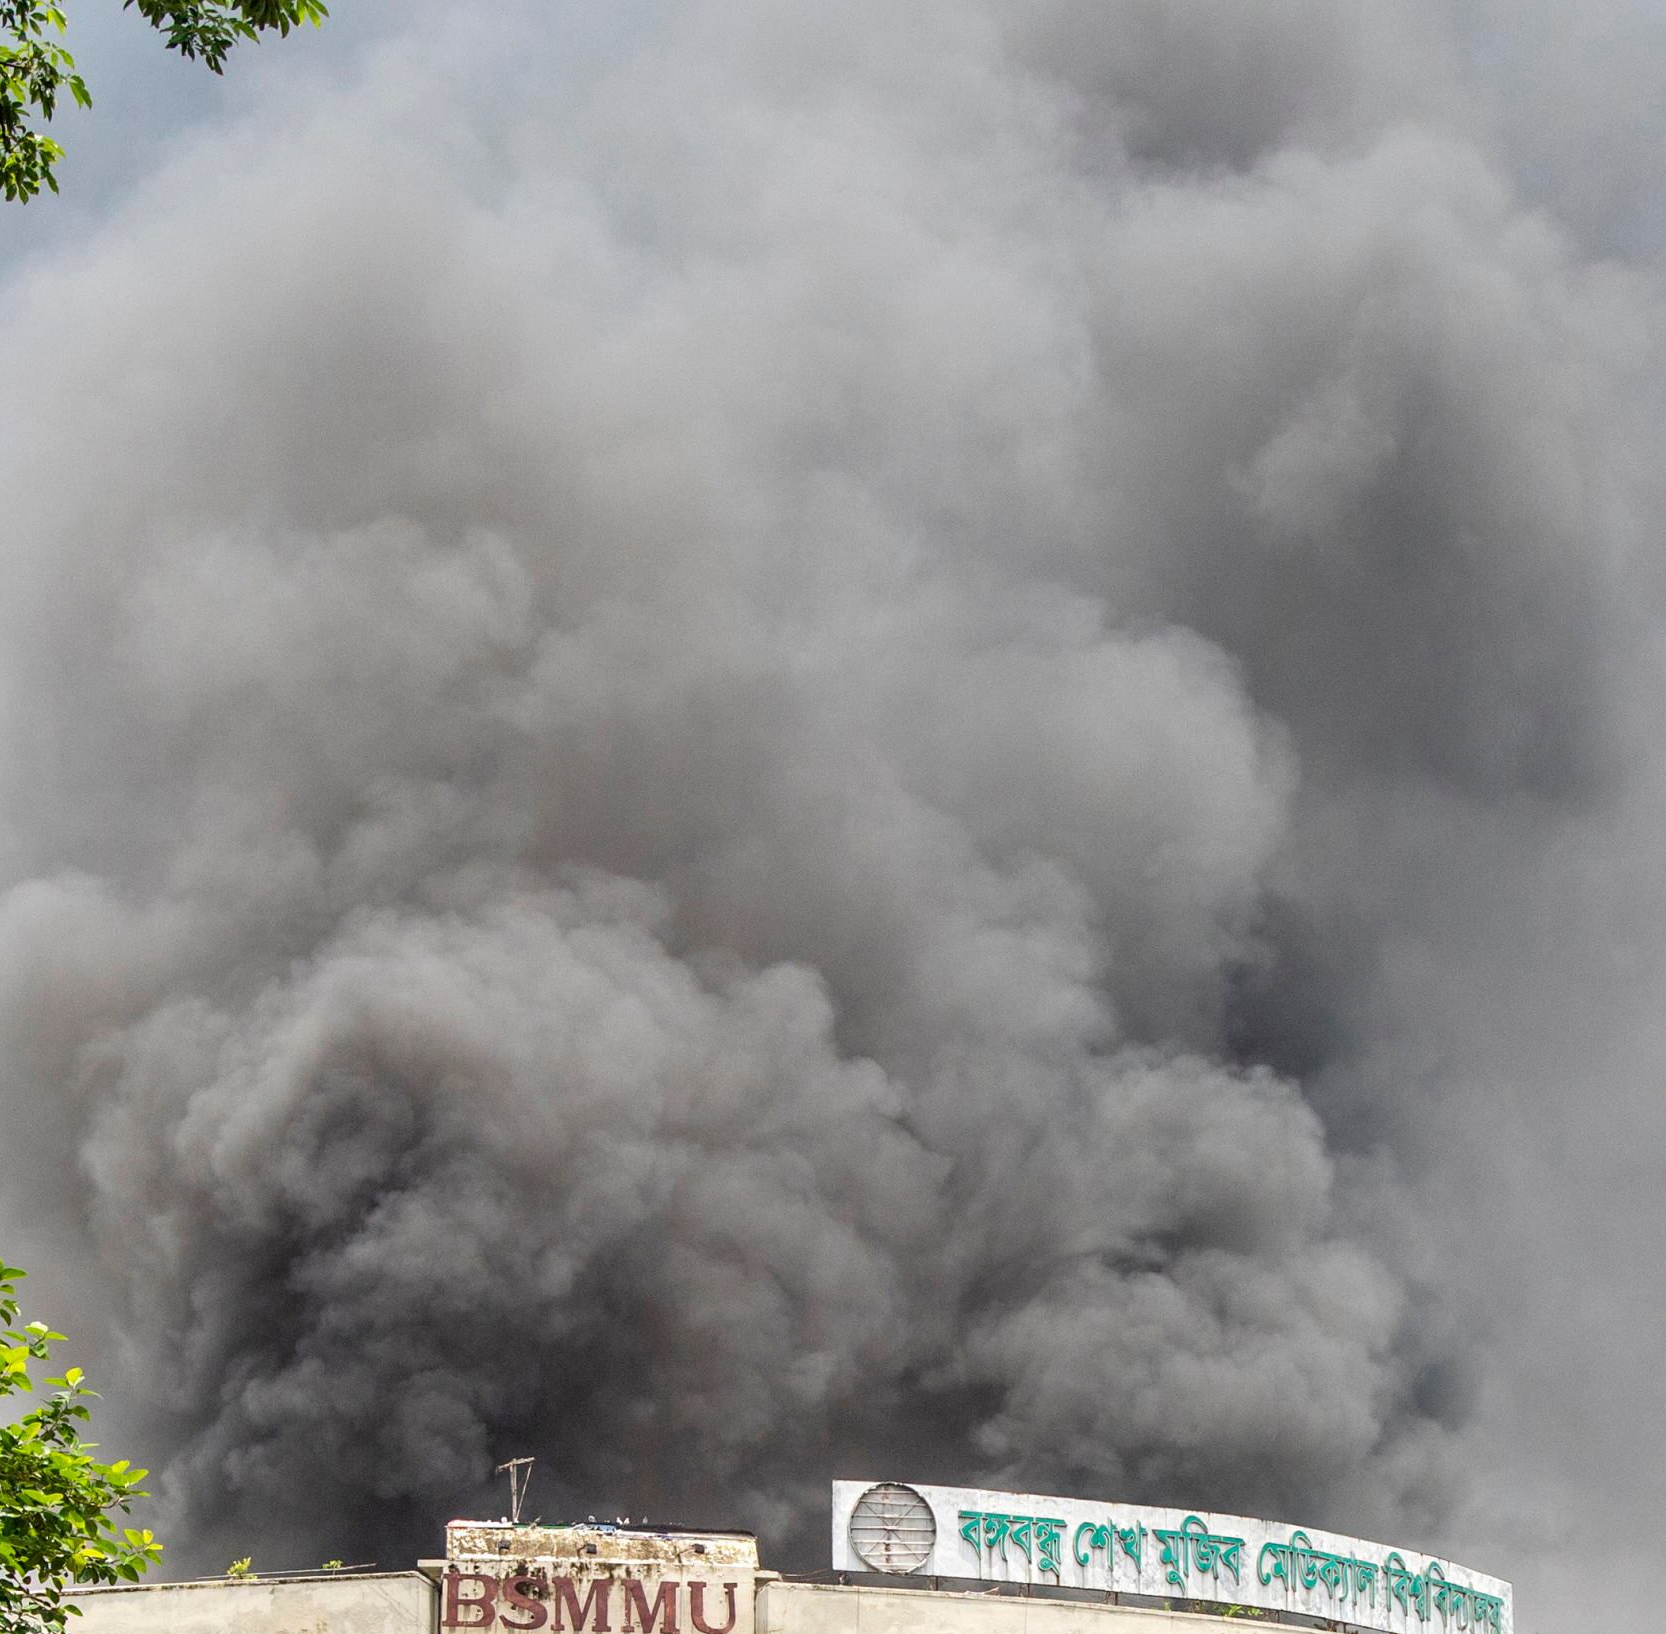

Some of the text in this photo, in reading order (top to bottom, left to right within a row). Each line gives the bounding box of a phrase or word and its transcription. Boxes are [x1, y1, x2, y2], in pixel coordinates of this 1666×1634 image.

[958, 1510, 1068, 1575] বঙ্গবন্ধু
[1073, 1520, 1147, 1574] শেখ
[1153, 1515, 1246, 1592] মুজিব
[1257, 1530, 1379, 1608] মেডিক্যাল
